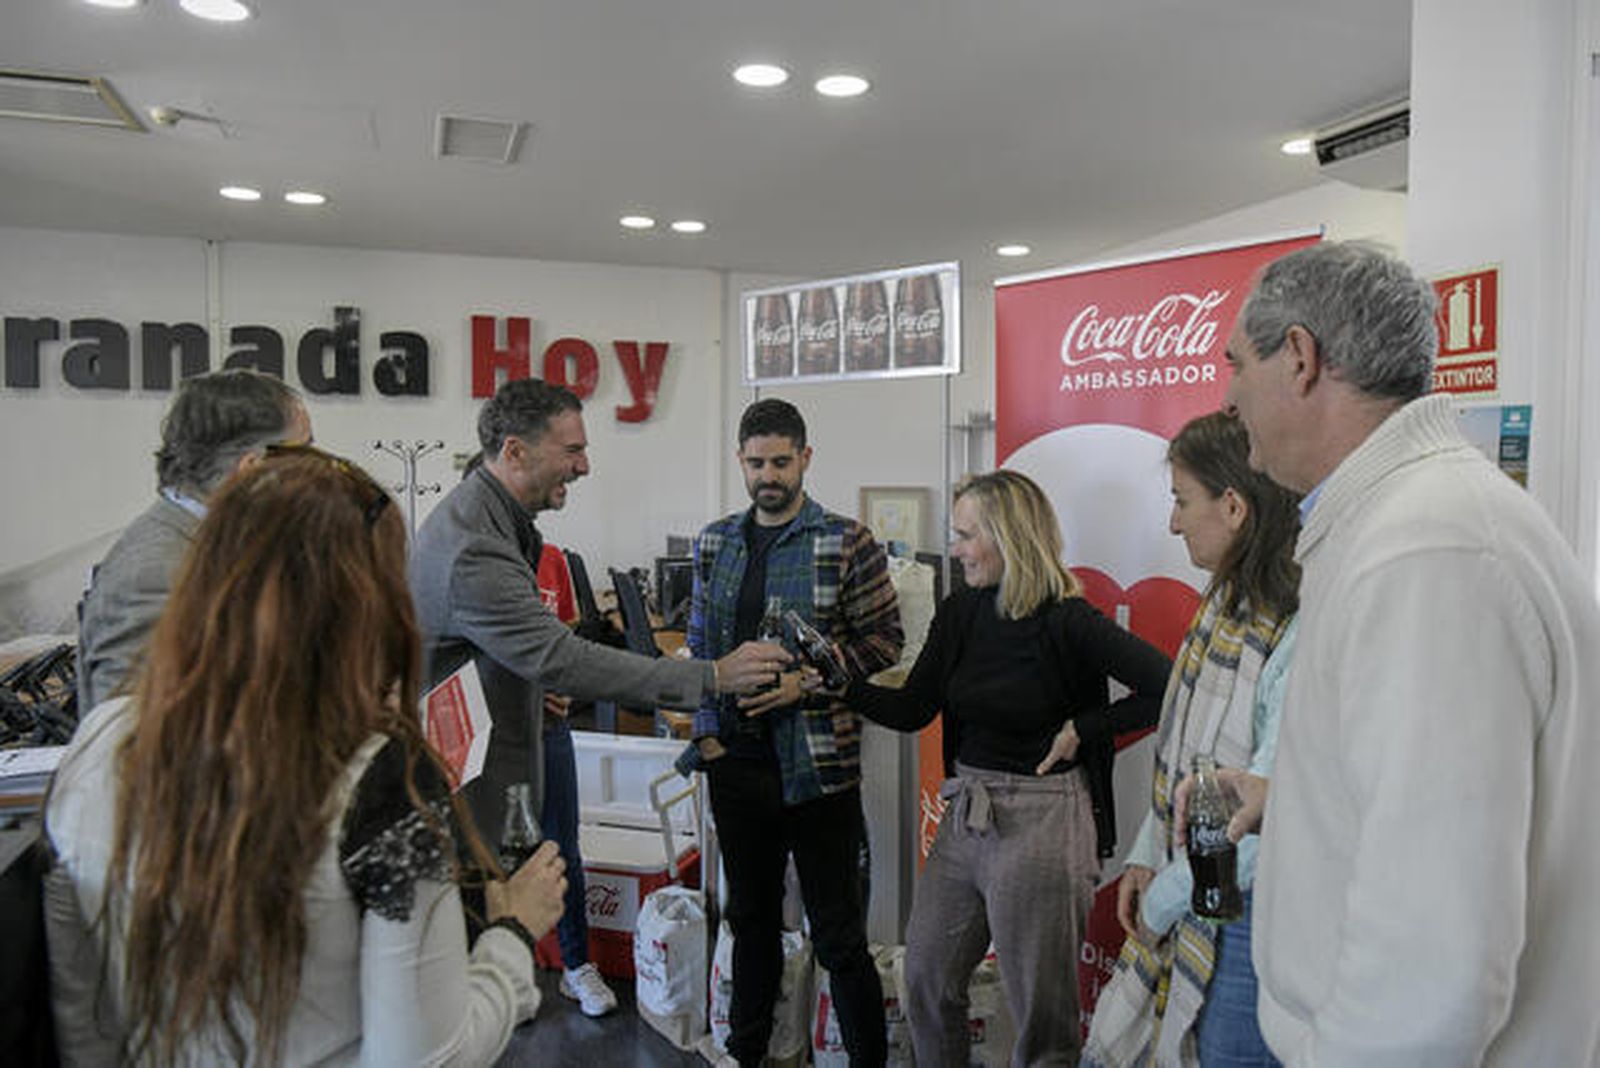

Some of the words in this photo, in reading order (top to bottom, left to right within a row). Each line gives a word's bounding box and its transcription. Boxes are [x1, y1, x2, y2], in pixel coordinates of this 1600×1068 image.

[1061, 290, 1231, 367] Coca-Cola
[471, 314, 669, 424] Hoy
[1059, 364, 1217, 392] AMBASSADOR
